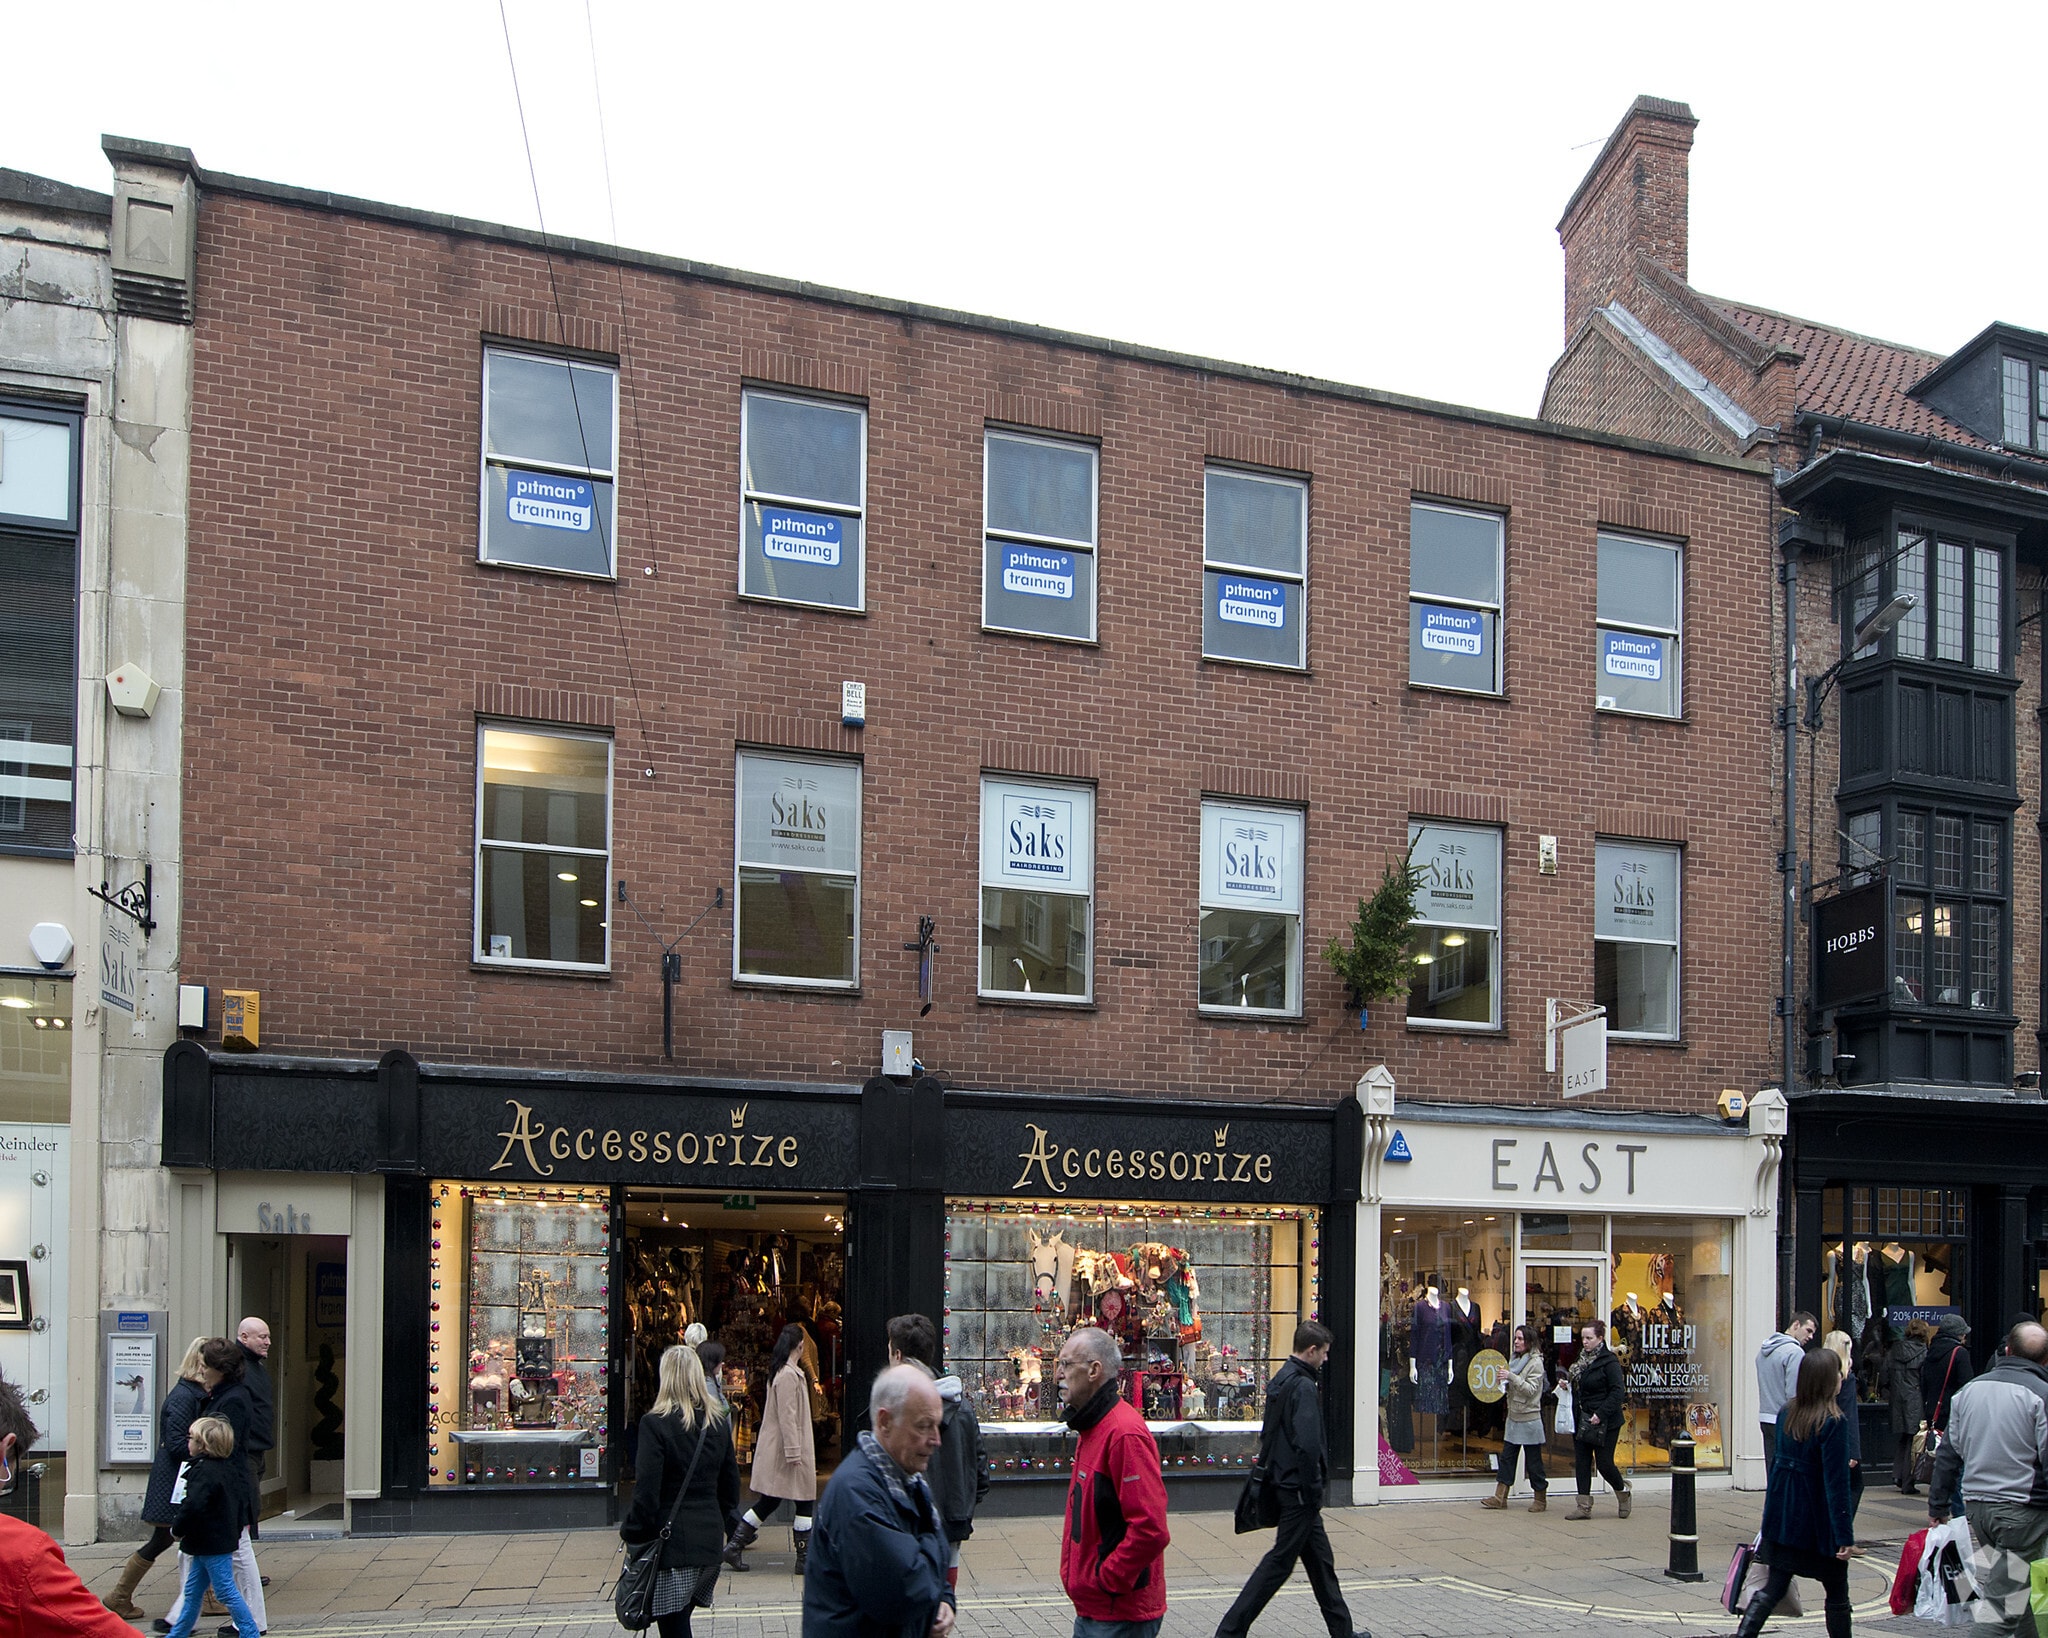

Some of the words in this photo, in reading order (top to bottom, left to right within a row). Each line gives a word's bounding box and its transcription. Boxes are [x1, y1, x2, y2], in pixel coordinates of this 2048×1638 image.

[517, 501, 582, 526] training
[771, 538, 832, 561] training
[1010, 572, 1066, 594] training
[1225, 602, 1277, 624] training
[1427, 632, 1475, 651] training
[1610, 657, 1655, 676] training
[846, 683, 863, 691] CHRIS
[846, 690, 863, 699] BELL
[771, 791, 826, 830] Saks
[773, 830, 824, 840] HAIRDRESSING
[1010, 819, 1064, 859] Saks
[771, 842, 826, 853] www.saks.co.uk
[1011, 862, 1063, 872] HAIRDRESSING
[1226, 841, 1275, 880] Saks
[1431, 856, 1474, 890] Saks
[1227, 882, 1274, 892] HAIRDRESSING
[1614, 874, 1654, 907] Saks
[1431, 902, 1473, 910] www.saks.co.uk
[1827, 926, 1875, 953] HOBBS
[102, 941, 134, 997] Saks
[1567, 1069, 1597, 1089] EAST
[0, 1136, 58, 1151] Reindeer
[489, 1099, 799, 1176] Accessorize
[1012, 1123, 1273, 1193] Accessorize
[1492, 1139, 1647, 1195] EAST
[258, 1201, 310, 1233] Saks
[1463, 1247, 1511, 1280] EAS
[1893, 1311, 1911, 1321] 20%
[1912, 1311, 1930, 1321] OFF
[1931, 1311, 1946, 1320] dre
[1642, 1324, 1669, 1348] LIFE
[1671, 1329, 1681, 1344] OF
[1684, 1324, 1696, 1349] PI
[1631, 1363, 1652, 1374] WIN
[1655, 1363, 1662, 1374] A
[1664, 1363, 1702, 1374] LUXURY
[1626, 1374, 1667, 1386] INDIAN
[1670, 1374, 1709, 1386] ESCAPE
[1385, 1448, 1403, 1471] SALE
[1402, 1459, 1420, 1470] shop
[1422, 1459, 1445, 1468] online
[1447, 1458, 1455, 1467] at
[1456, 1458, 1491, 1467] east.co.u
